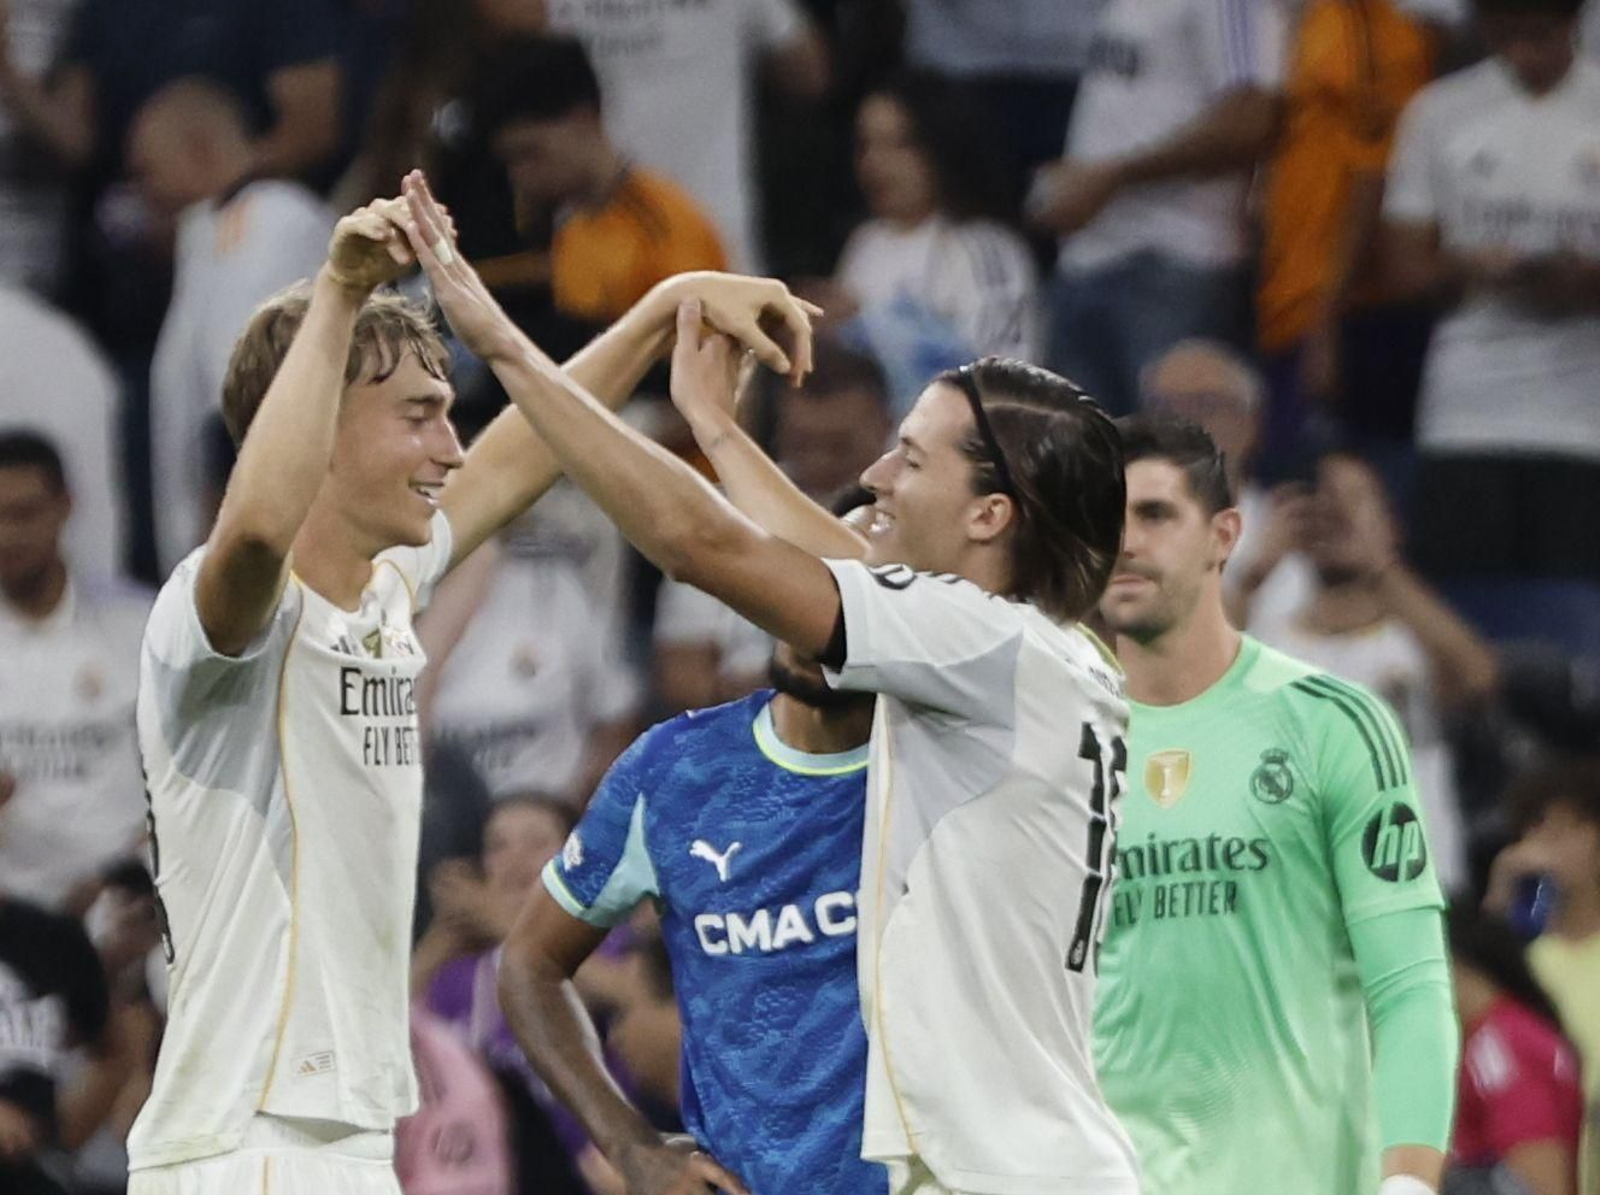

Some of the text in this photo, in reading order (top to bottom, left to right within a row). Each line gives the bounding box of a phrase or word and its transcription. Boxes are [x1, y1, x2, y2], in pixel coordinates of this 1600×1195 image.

[364, 726, 389, 765] FLY
[1369, 802, 1422, 882] hp
[1154, 880, 1237, 919] BETTER
